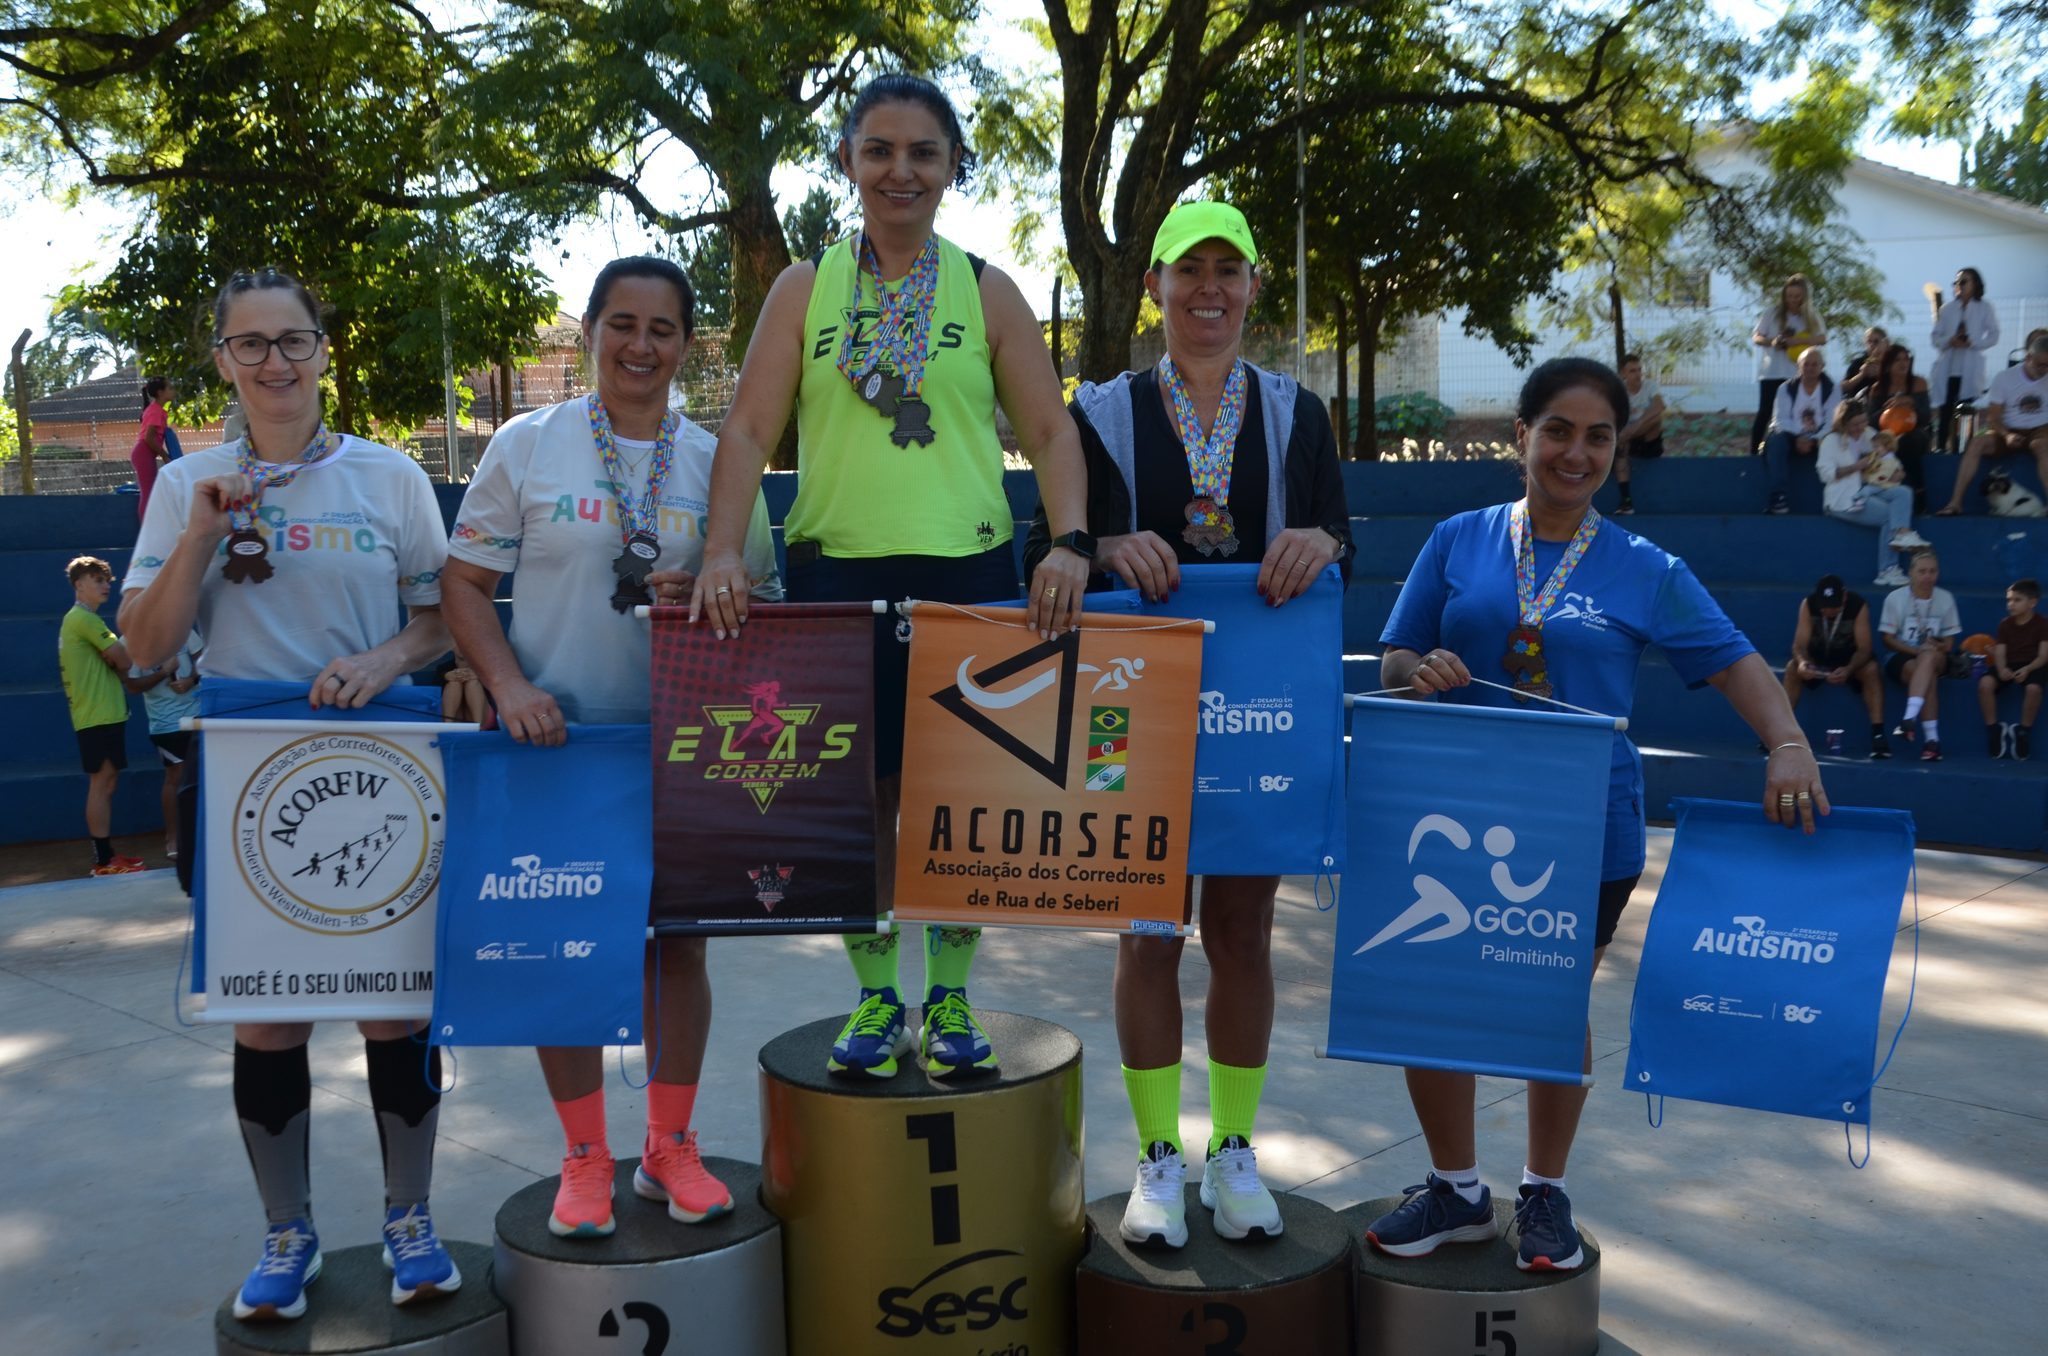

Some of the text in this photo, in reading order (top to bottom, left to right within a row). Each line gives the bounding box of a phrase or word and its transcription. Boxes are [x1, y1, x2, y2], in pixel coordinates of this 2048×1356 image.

[258, 518, 377, 553] ismo
[1197, 707, 1293, 734] tismo
[667, 723, 858, 762] ELAS
[250, 737, 433, 802] Associação de Corredores de Rua
[703, 762, 822, 780] CORREM
[270, 771, 389, 849] ACORFW
[929, 805, 1169, 861] ACORSEB
[242, 829, 269, 888] Frederico
[923, 858, 1166, 885] Associação dos Corredores
[401, 873, 434, 907] Desde
[478, 871, 603, 900] Autismo
[967, 889, 1119, 912] de Rua de Seberi
[1474, 904, 1578, 940] GCOR
[1481, 944, 1576, 969] Palmitinho
[1692, 927, 1835, 964] Autismo
[220, 969, 433, 997] VOCÊ É O SEU ÚNICO LIM
[906, 1111, 961, 1246] 1
[876, 1274, 1028, 1338] sesc
